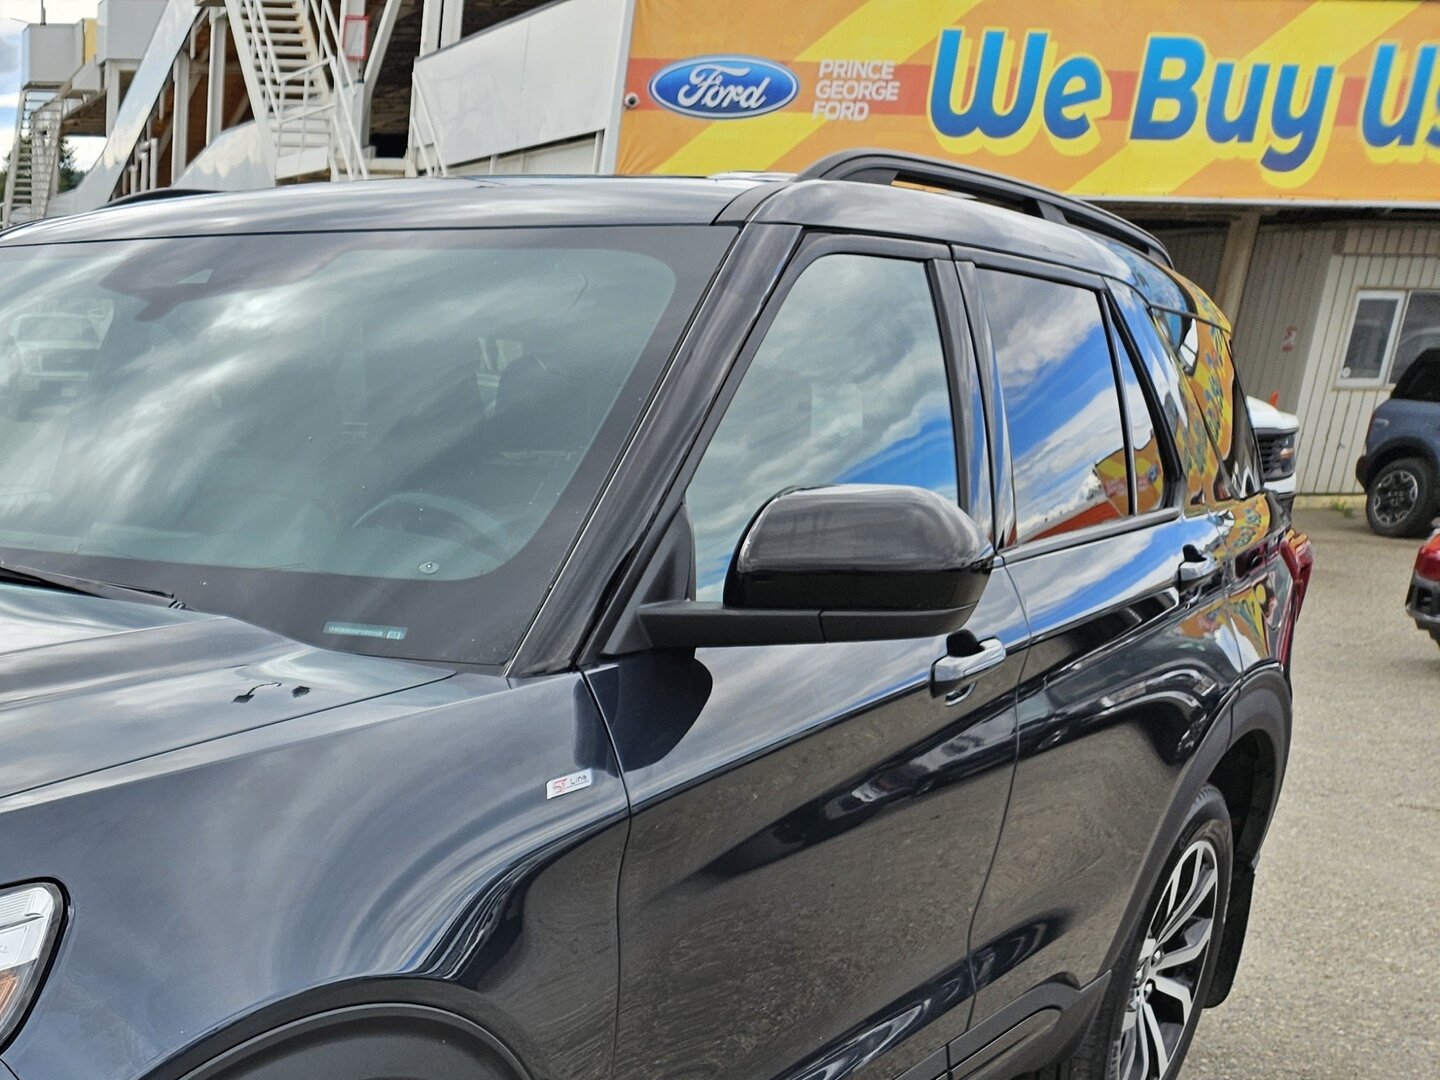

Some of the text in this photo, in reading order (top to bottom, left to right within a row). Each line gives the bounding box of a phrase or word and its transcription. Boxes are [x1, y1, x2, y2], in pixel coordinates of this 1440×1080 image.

[818, 58, 897, 81] PRINCE
[677, 63, 772, 110] Ford
[815, 80, 901, 101] GEORGE
[812, 101, 870, 122] FORD
[930, 28, 1103, 141] We
[1129, 36, 1336, 174] Buy
